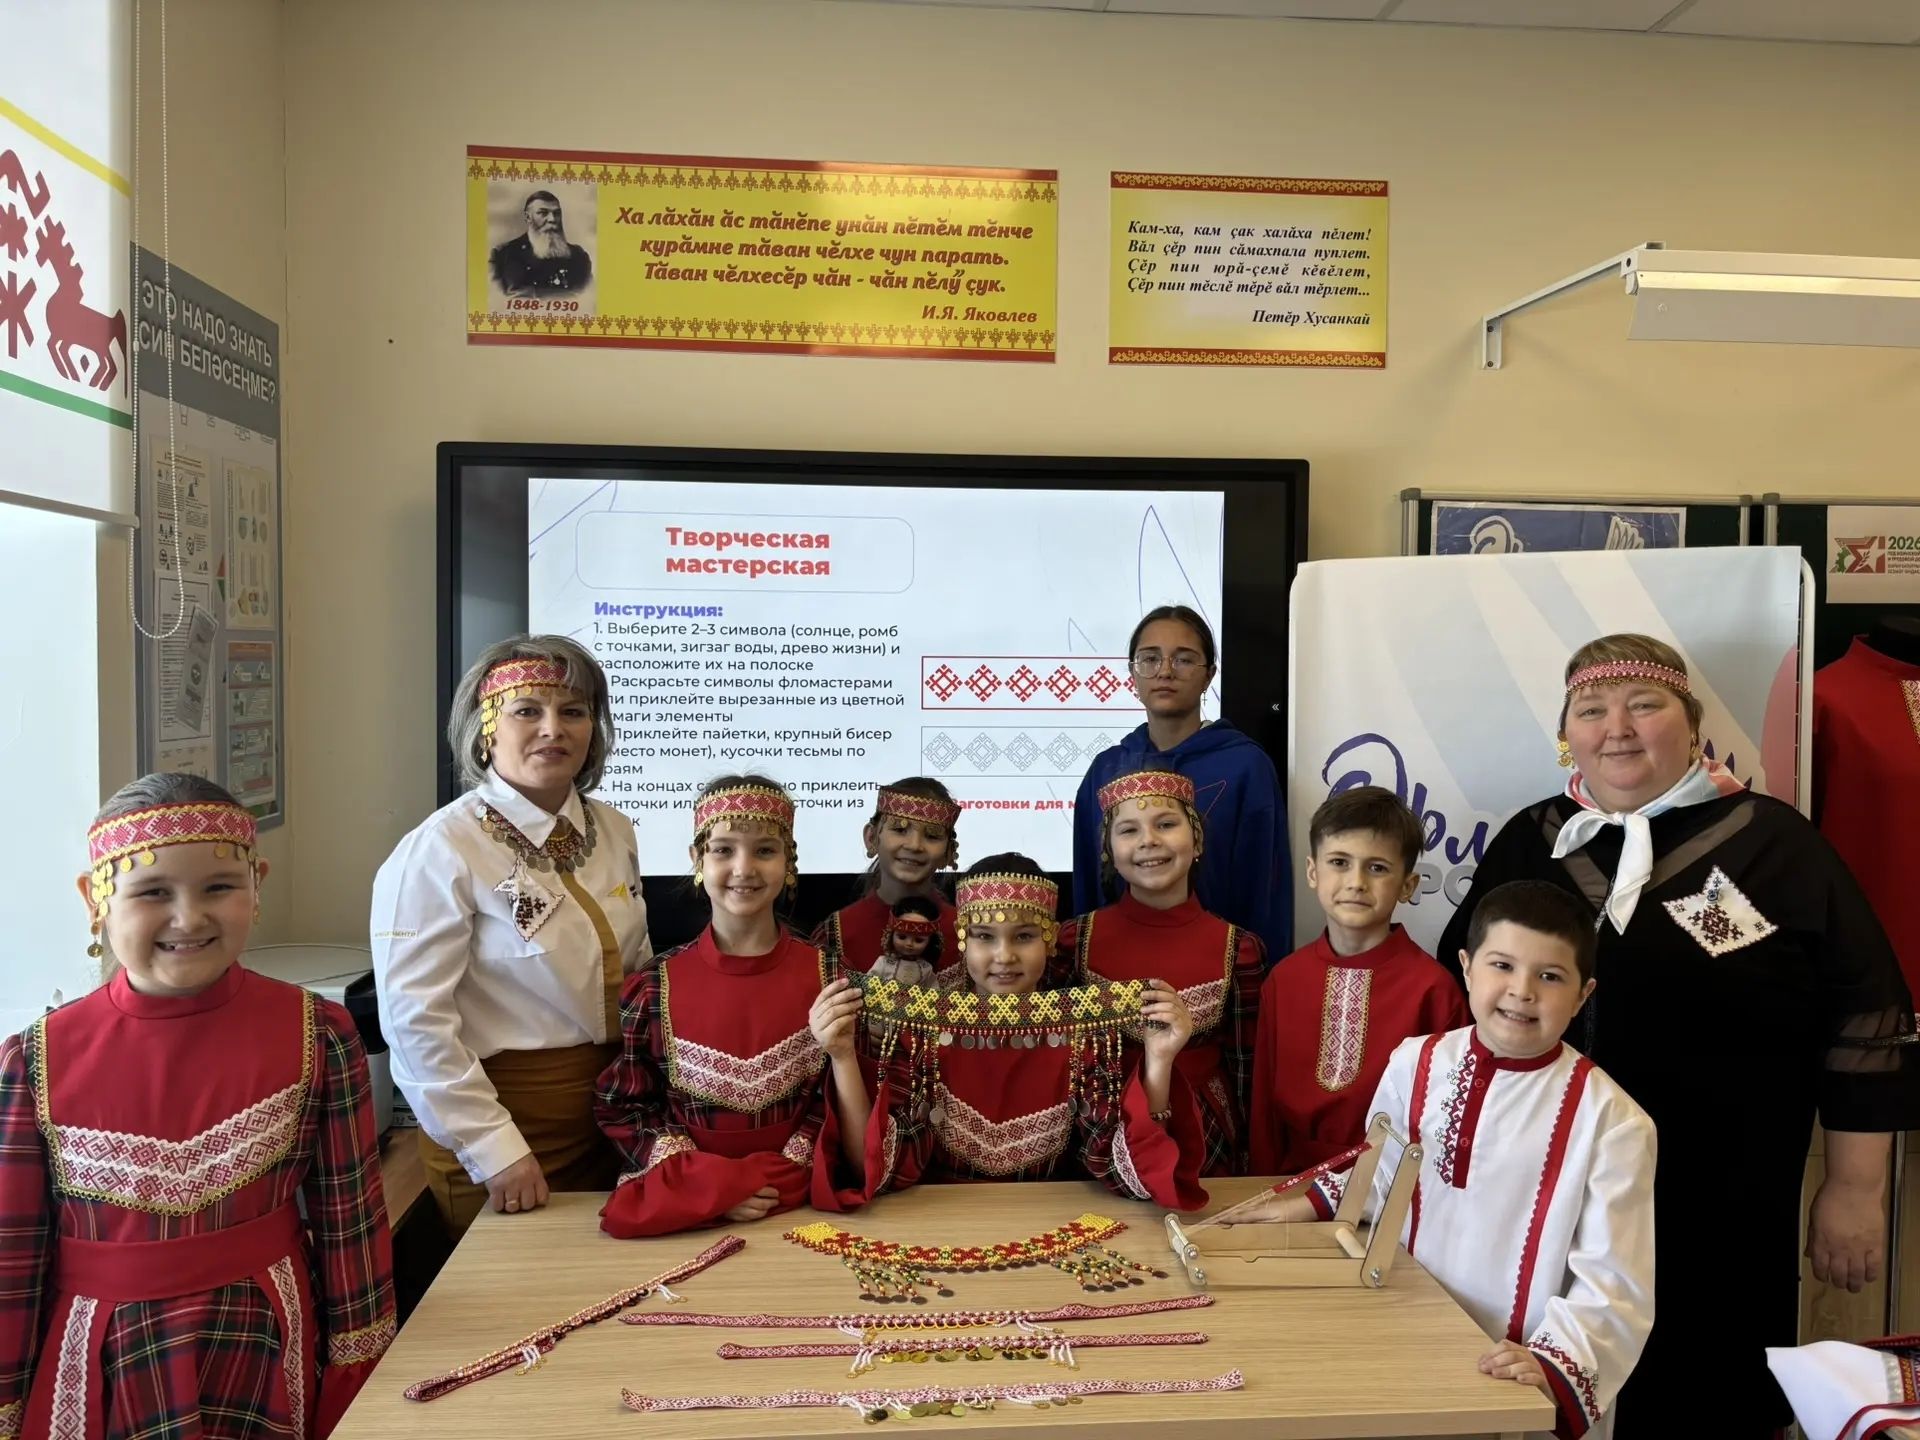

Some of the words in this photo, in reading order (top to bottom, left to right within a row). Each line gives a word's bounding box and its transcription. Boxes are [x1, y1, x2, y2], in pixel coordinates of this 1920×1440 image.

[1127, 221, 1184, 237] Кам-ха,
[1194, 225, 1221, 237] кам
[879, 249, 917, 265] чун
[921, 250, 1009, 267] парать.
[1194, 244, 1221, 255] пин
[1314, 248, 1371, 261] пуплет.
[1171, 263, 1200, 273] пин
[1158, 281, 1185, 291] пин
[506, 299, 579, 312] 1848-1930
[922, 305, 958, 321] И.Я.
[963, 307, 1038, 323] Яковлев
[1303, 311, 1370, 327] Хусанкай
[142, 280, 177, 320] ЭТО
[182, 300, 226, 345] НАДО
[229, 325, 272, 367] ЗНАТЬ
[665, 527, 830, 551] Творческая
[666, 556, 830, 578] мастерская
[594, 602, 723, 619] Инструкция:
[594, 622, 603, 634] 1.
[607, 622, 687, 637] Выберите
[720, 625, 786, 637] символа
[790, 623, 855, 640] (солнце,
[859, 624, 898, 641] ромб
[594, 643, 603, 653] с
[606, 642, 676, 655] точками,
[680, 643, 730, 654] зигзаг
[735, 643, 777, 657] воды,
[781, 644, 828, 658] древо
[832, 641, 886, 657] жизни)
[891, 645, 900, 655] и
[705, 660, 723, 671] их
[727, 660, 746, 671] на
[750, 660, 814, 671] полоске
[611, 675, 700, 690] Раскрасьте
[704, 677, 774, 689] символы
[778, 675, 893, 691] фломастерами
[630, 693, 714, 707] приклейте
[719, 695, 816, 708] вырезанные
[820, 695, 837, 706] из
[842, 692, 905, 709] цветной
[612, 713, 651, 722] маги
[655, 713, 733, 722] элементы
[702, 727, 770, 743] пайетки,
[774, 727, 842, 745] крупный
[846, 728, 892, 744] бисер
[660, 745, 716, 759] монет),
[720, 747, 782, 760] кусочки
[787, 747, 842, 758] тесьмы
[847, 747, 866, 758] по
[604, 765, 643, 776] раям
[612, 780, 632, 792] На
[637, 782, 692, 793] концах
[847, 799, 864, 808] из
[1035, 800, 1063, 810] для
